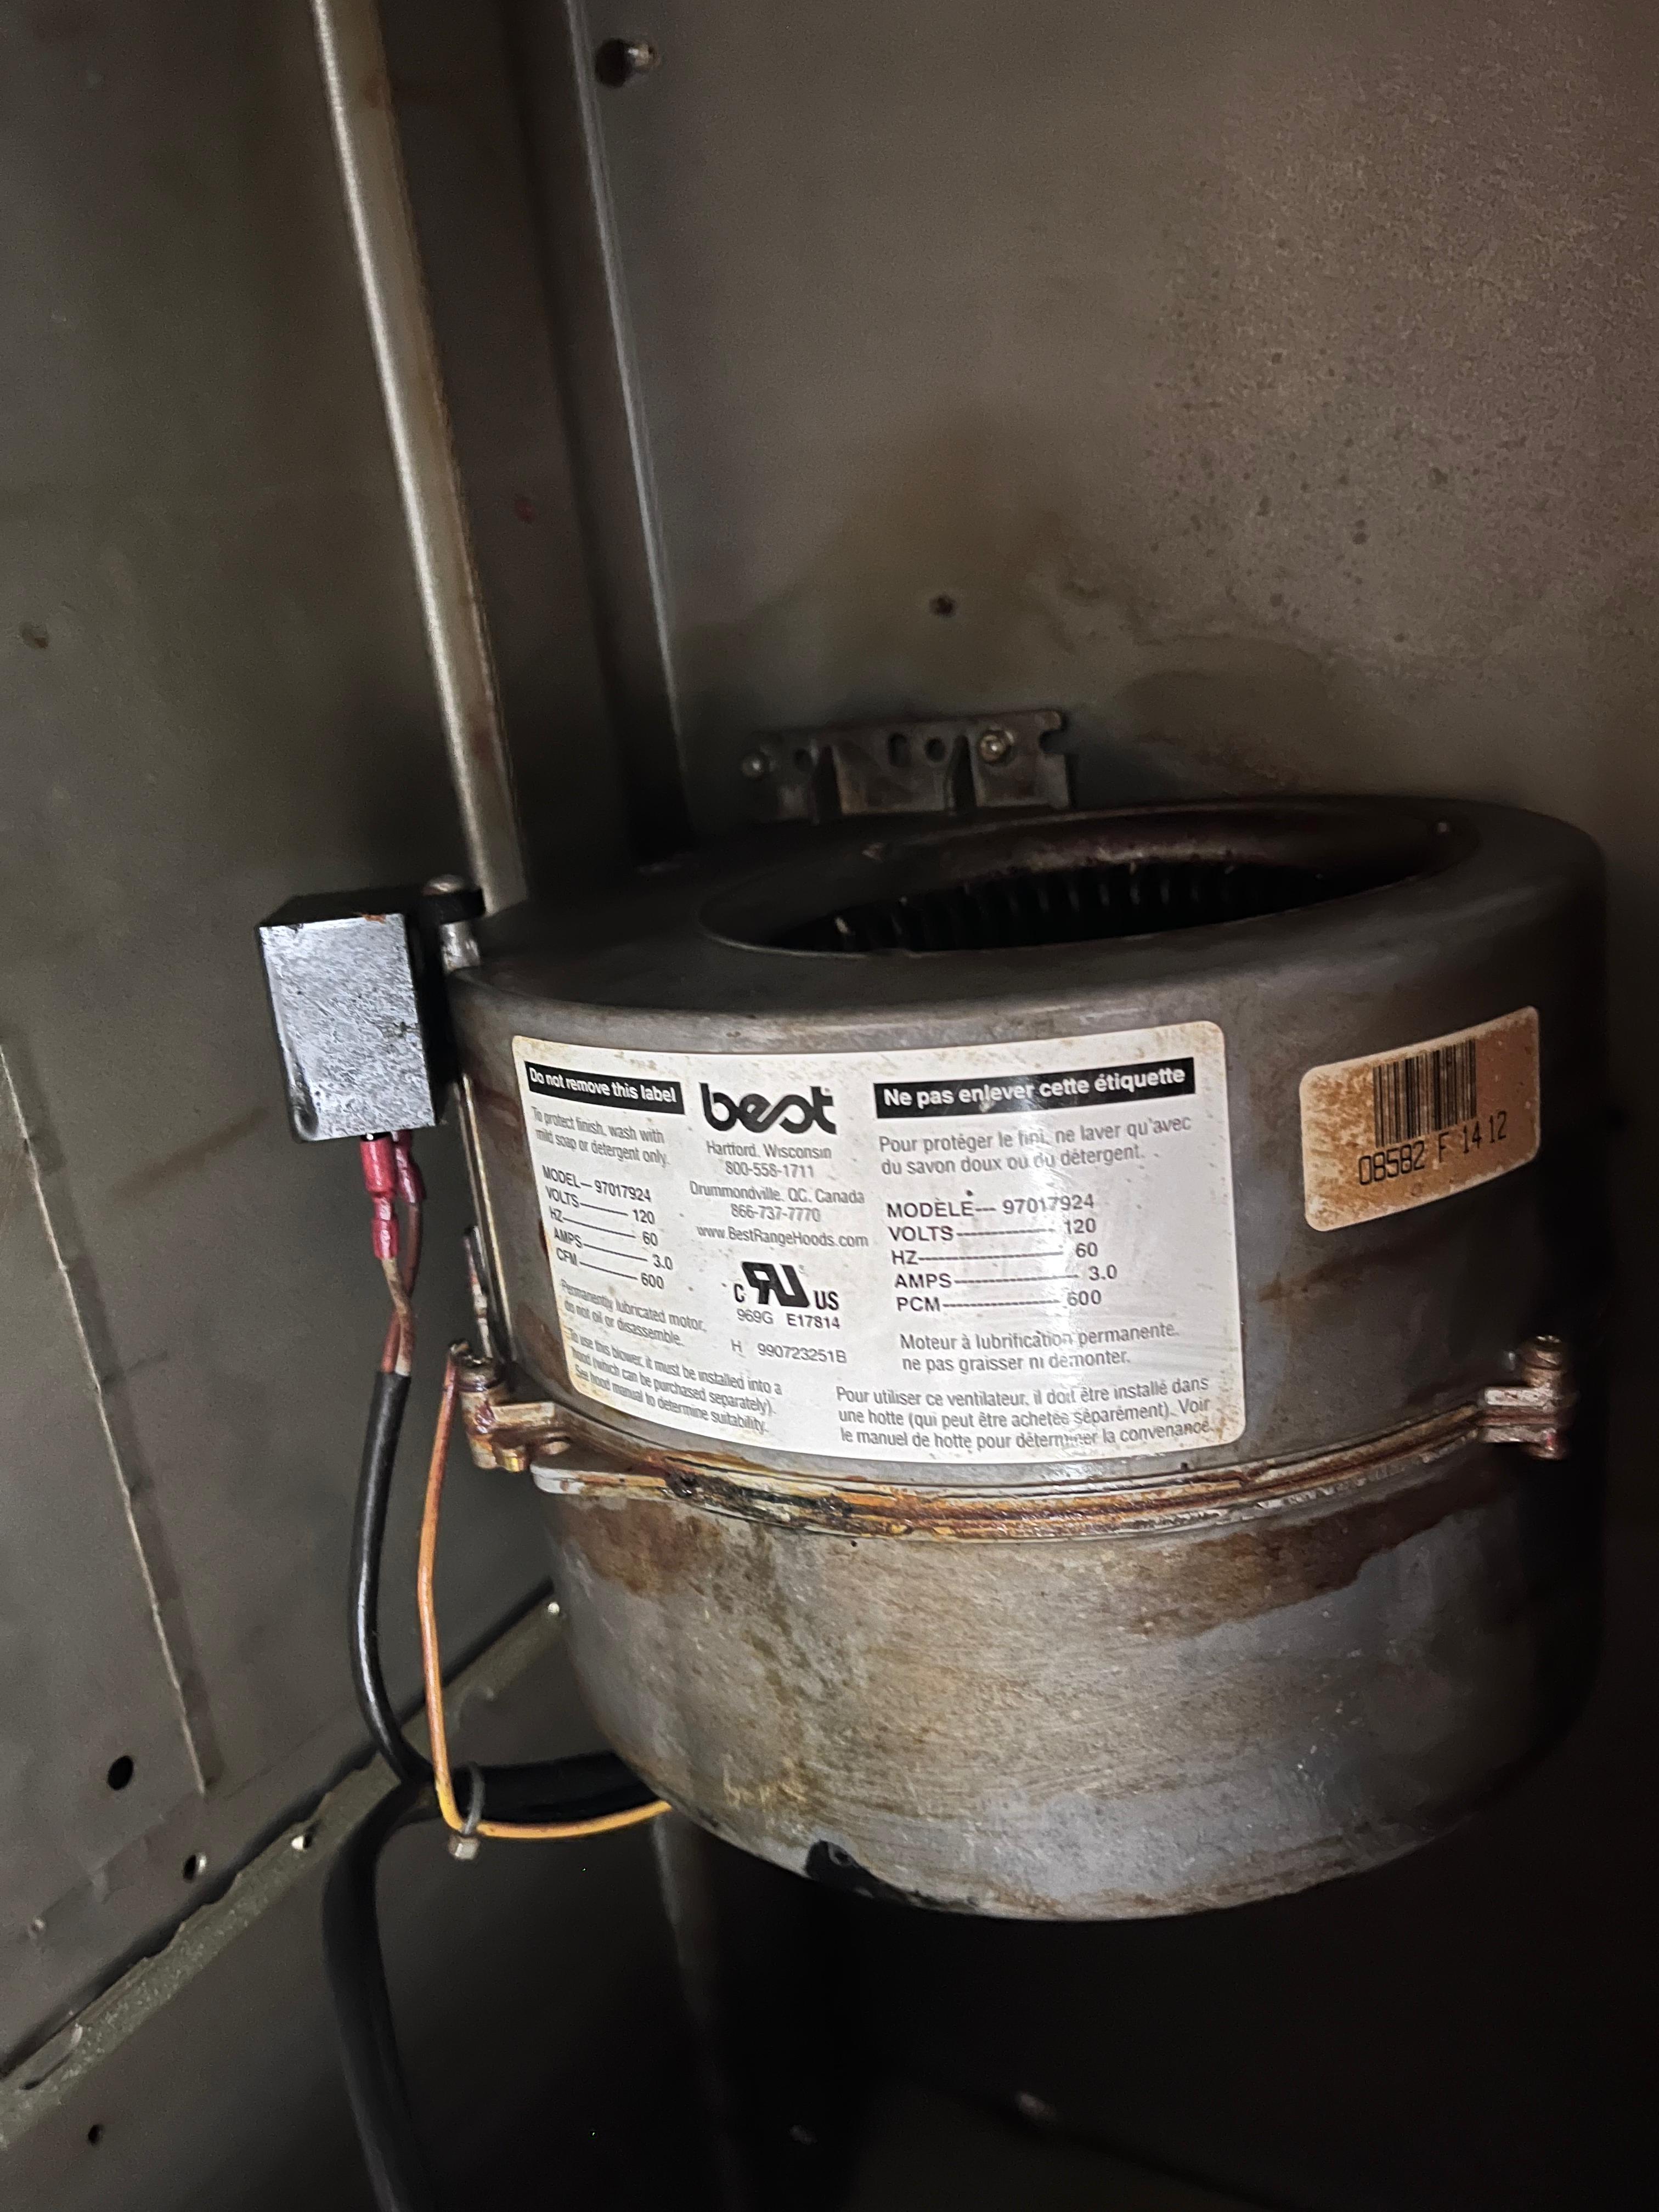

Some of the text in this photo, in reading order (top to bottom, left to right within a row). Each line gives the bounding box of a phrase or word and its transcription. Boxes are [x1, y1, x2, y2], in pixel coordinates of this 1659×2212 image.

[529, 1067, 678, 1103] Do not remove this label
[883, 1068, 1186, 1109] Ne pas enlever cette étiquette
[698, 1082, 837, 1135] best
[608, 1125, 637, 1141] wash
[639, 1127, 665, 1144] with
[878, 1136, 917, 1153] Pour
[923, 1133, 993, 1154] protéger
[996, 1131, 1013, 1148] le
[1055, 1128, 1075, 1144] ne
[1080, 1124, 1121, 1142] laver
[1127, 1116, 1192, 1139] qu'avec
[555, 1135, 577, 1152] soap
[579, 1140, 589, 1152] or
[591, 1140, 640, 1161] detergent
[763, 1143, 832, 1159] Wisconsin
[881, 1144, 1146, 1175] du savon doux ou du détergent.
[1438, 1132, 1449, 1163] F
[725, 1160, 814, 1177] 800-558-1711
[595, 1180, 652, 1203] 97017924
[815, 1188, 865, 1204] Canada
[1002, 1193, 1094, 1215] 97017924
[545, 1185, 656, 1224] VOLTS 120
[731, 1203, 821, 1222] 866-737-7770
[549, 1206, 658, 1246] HZ 60
[696, 1226, 869, 1248] www.BestRangeHoods.com
[887, 1217, 1097, 1242] VOLTS 120
[554, 1227, 673, 1270] AMPS 3.0
[891, 1242, 1098, 1265] HZ 60
[641, 1272, 664, 1290] 600
[894, 1265, 1118, 1289] AMPS 3.0
[615, 1298, 667, 1324] lubricated
[896, 1289, 1102, 1312] PCM 600
[736, 1308, 840, 1329] 969G E17814
[900, 1322, 1178, 1350] Moteur à lubrification permanente.
[731, 1339, 847, 1364] H 990723251B
[654, 1360, 681, 1377] must
[682, 1364, 697, 1381] be
[698, 1371, 745, 1390] installed
[747, 1376, 771, 1394] into
[774, 1383, 782, 1395] a
[902, 1357, 921, 1371] ne
[926, 1358, 955, 1373] pas
[959, 1356, 1024, 1374] graisser
[1029, 1357, 1044, 1369] ni
[639, 1372, 652, 1387] be
[653, 1378, 707, 1402] purchased
[836, 1386, 870, 1403] Pour
[873, 1389, 922, 1406] utiliser
[925, 1392, 943, 1406] ce
[1033, 1390, 1042, 1406] il
[1080, 1386, 1109, 1403] être
[1172, 1377, 1209, 1394] dans
[658, 1397, 709, 1421] determine
[838, 1409, 865, 1424] une
[868, 1409, 904, 1426] hotte
[909, 1412, 938, 1429] (qui
[941, 1413, 975, 1430] peut
[978, 1411, 1008, 1427] être
[1177, 1397, 1210, 1414] Voir
[840, 1427, 853, 1443] le
[857, 1430, 909, 1446] manuel
[912, 1431, 930, 1447] de
[933, 1432, 972, 1449] hotte
[976, 1435, 1011, 1451] pour
[1103, 1427, 1116, 1443] la
